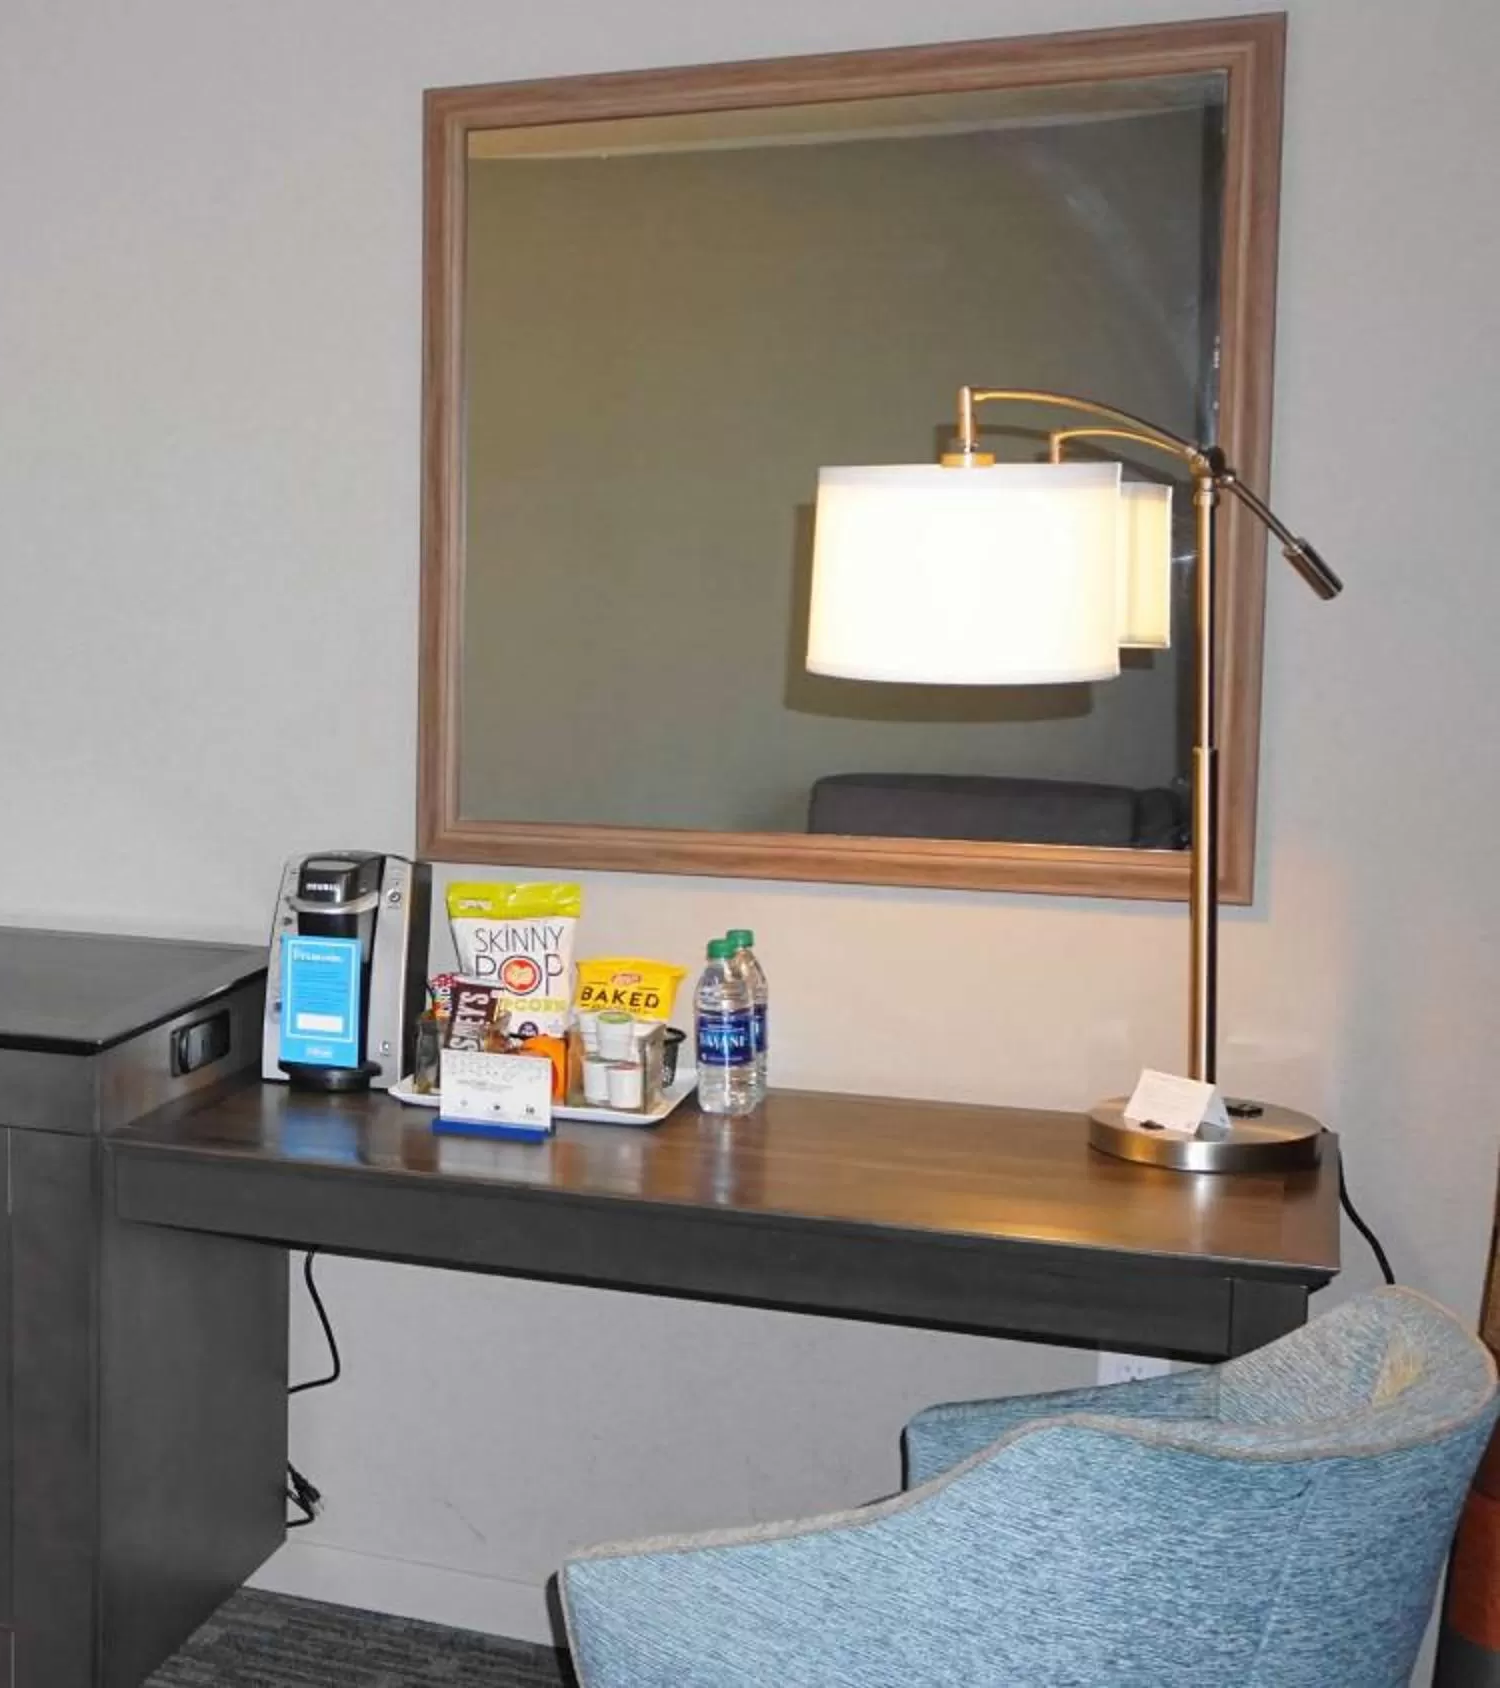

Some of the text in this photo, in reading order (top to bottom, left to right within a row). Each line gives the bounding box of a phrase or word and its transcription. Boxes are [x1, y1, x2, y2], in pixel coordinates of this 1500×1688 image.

[475, 922, 565, 952] SKINNY
[474, 953, 564, 997] POP
[580, 985, 660, 1009] BAKED
